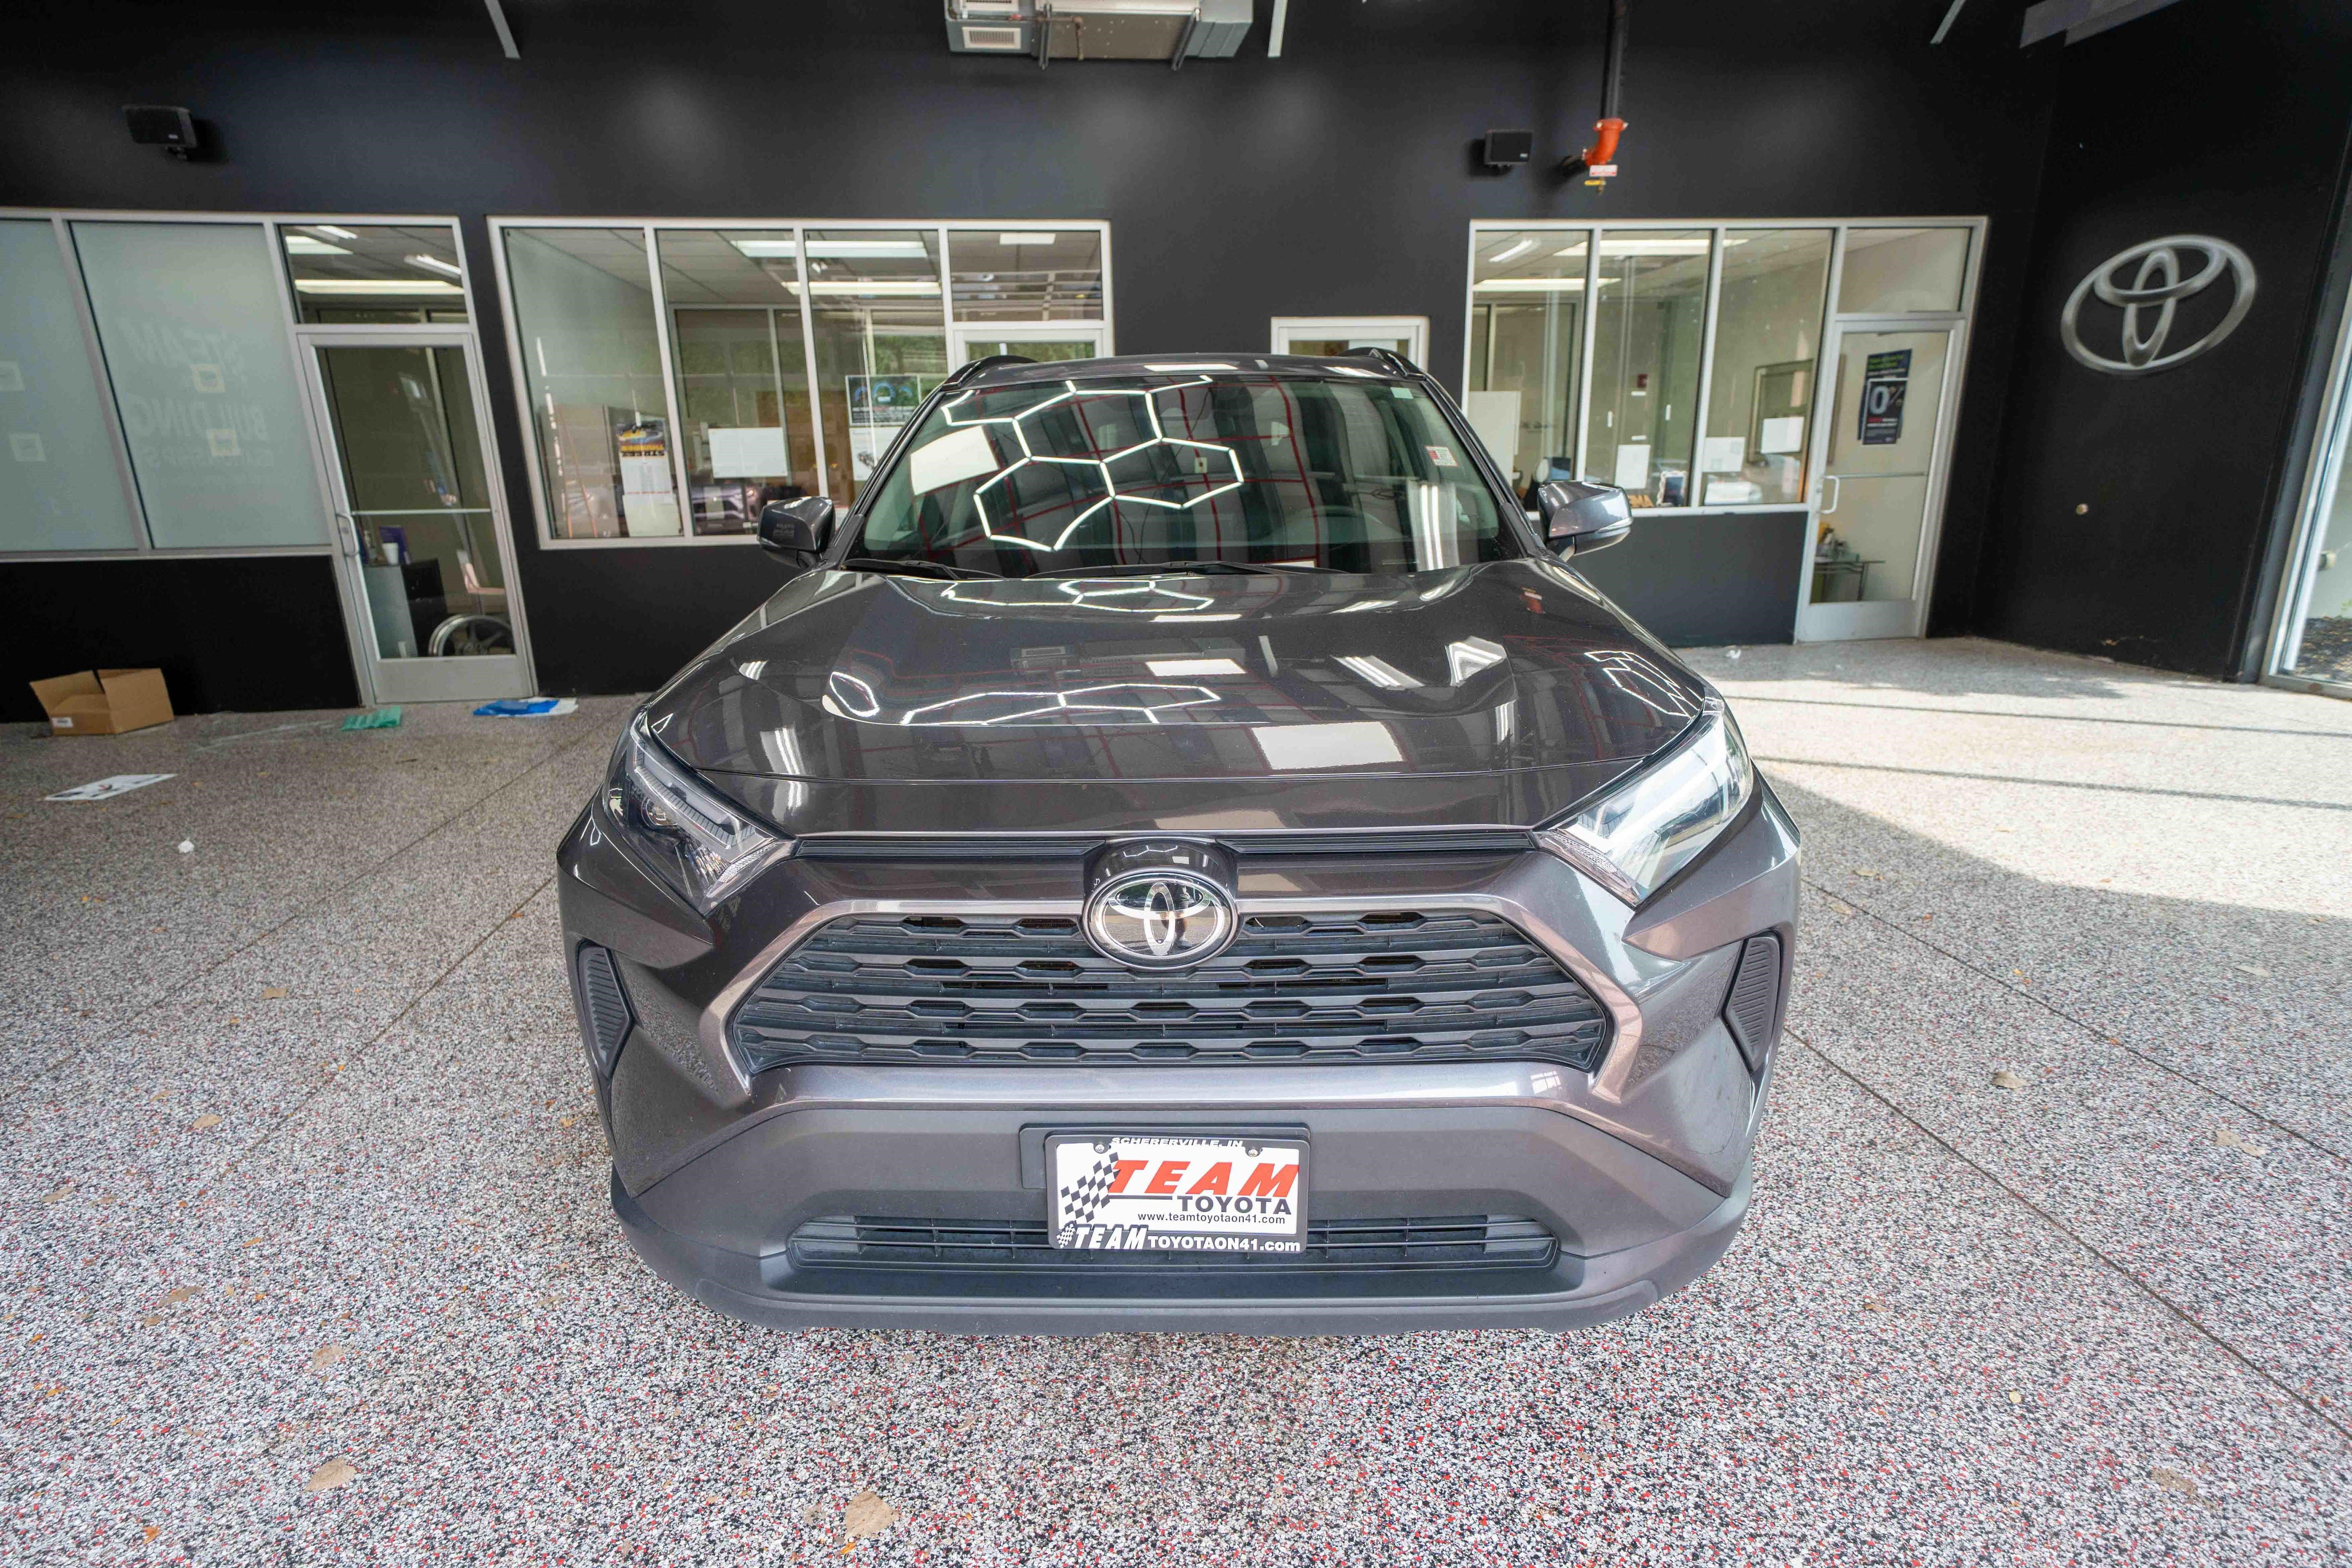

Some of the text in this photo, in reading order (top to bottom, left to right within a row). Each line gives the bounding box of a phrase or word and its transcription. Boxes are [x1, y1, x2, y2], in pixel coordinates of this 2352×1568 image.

[1108, 1160, 1298, 1197] TEAM
[1177, 1196, 1292, 1215] TOYOTA
[1138, 1213, 1285, 1224] www.teamtoyotaon41.com
[1074, 1227, 1301, 1252] TEAM TOYOTAON41.com
